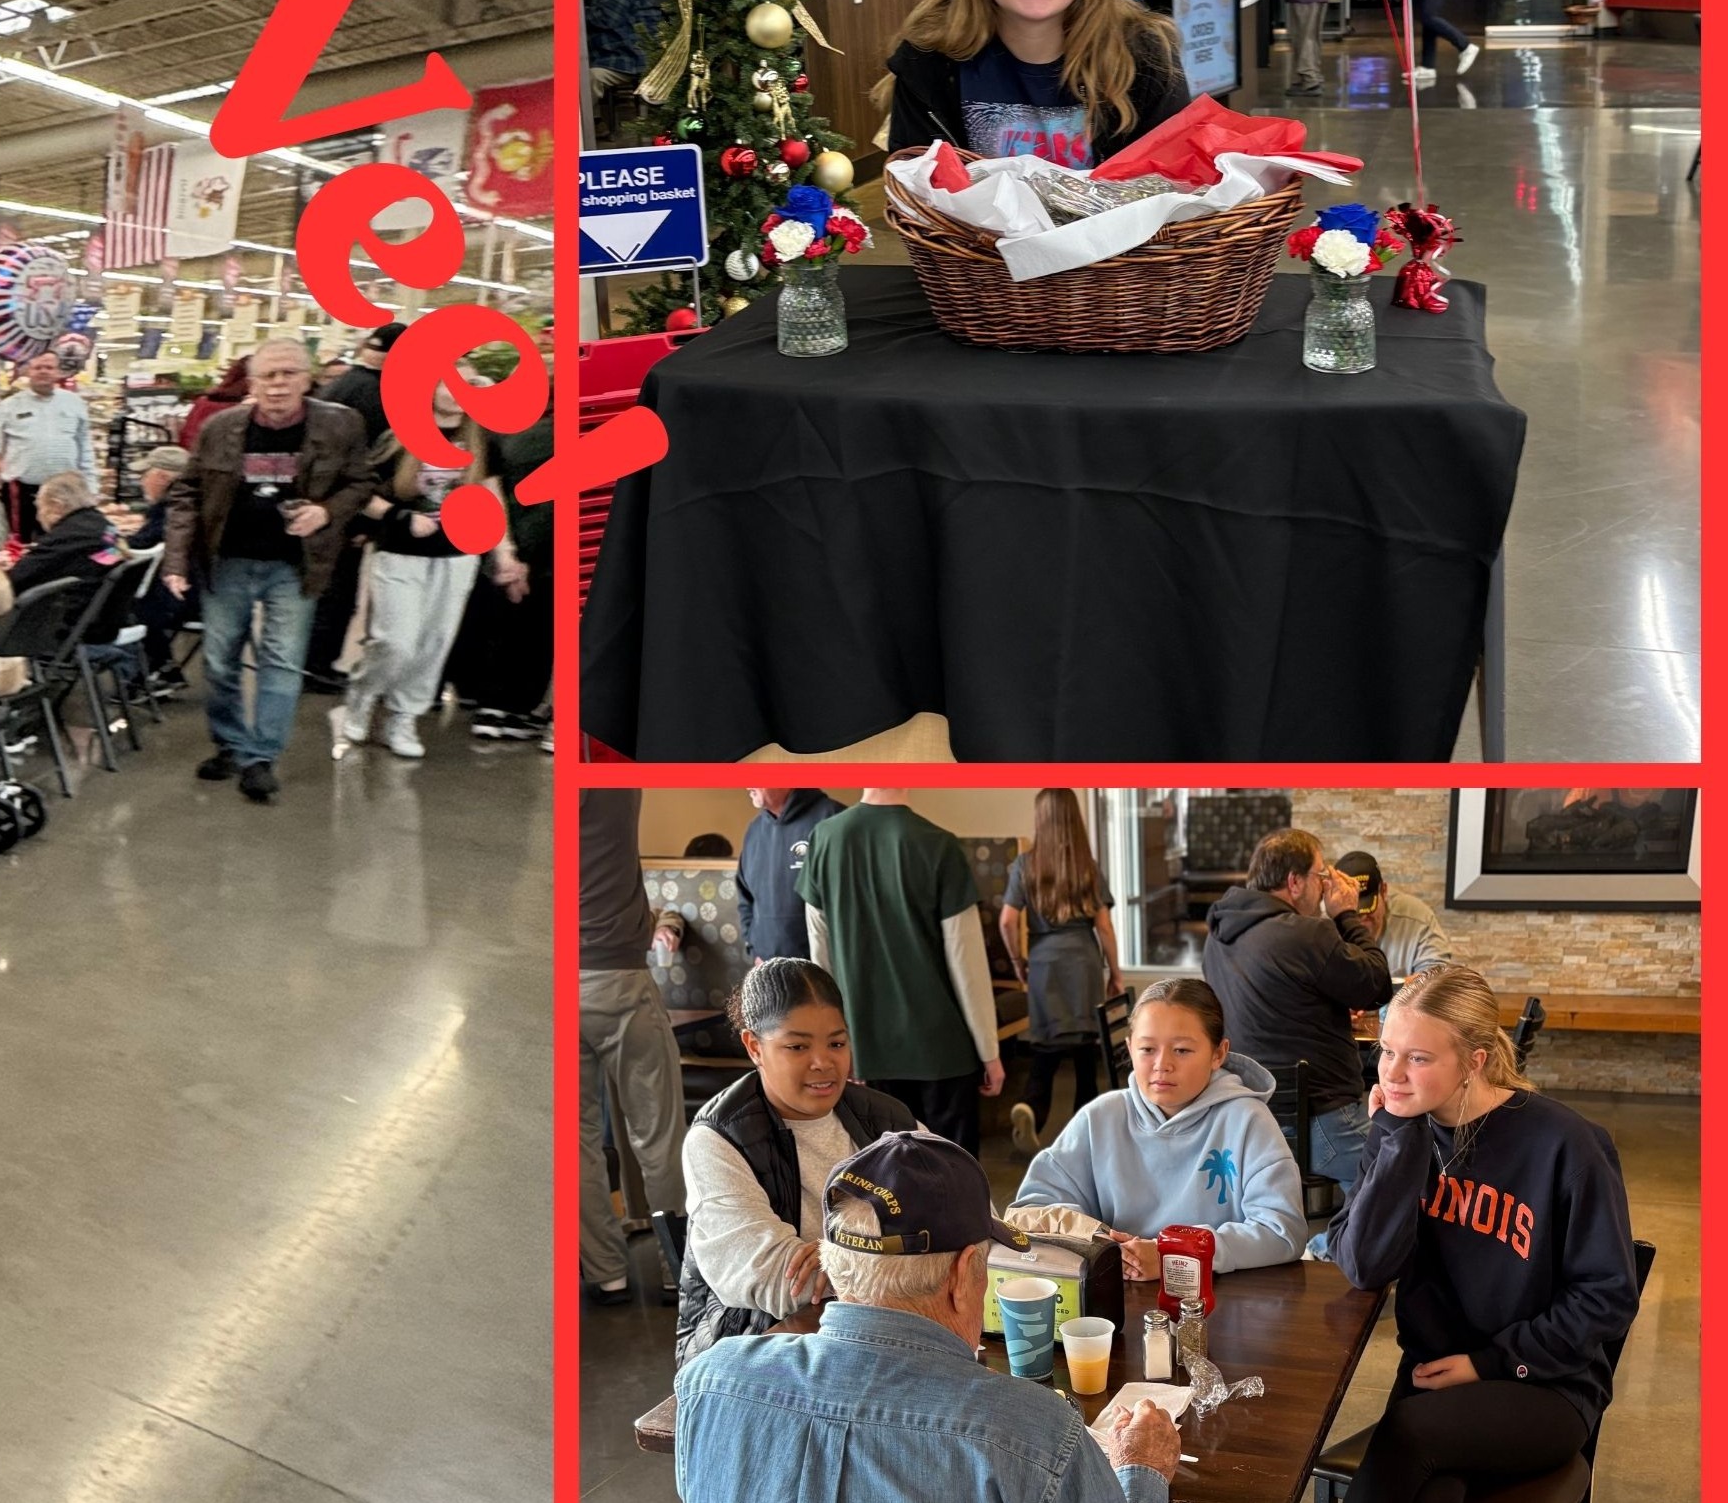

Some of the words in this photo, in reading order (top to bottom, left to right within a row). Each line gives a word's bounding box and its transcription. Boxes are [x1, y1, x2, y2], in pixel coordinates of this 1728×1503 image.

[581, 192, 648, 208] shopping
[649, 185, 696, 203] basket
[837, 1171, 873, 1192] ARINE
[873, 1186, 902, 1216] CORPS
[1425, 1173, 1535, 1261] INOIS
[834, 1230, 884, 1252] VETERAN
[1171, 1259, 1189, 1268] HEINZ
